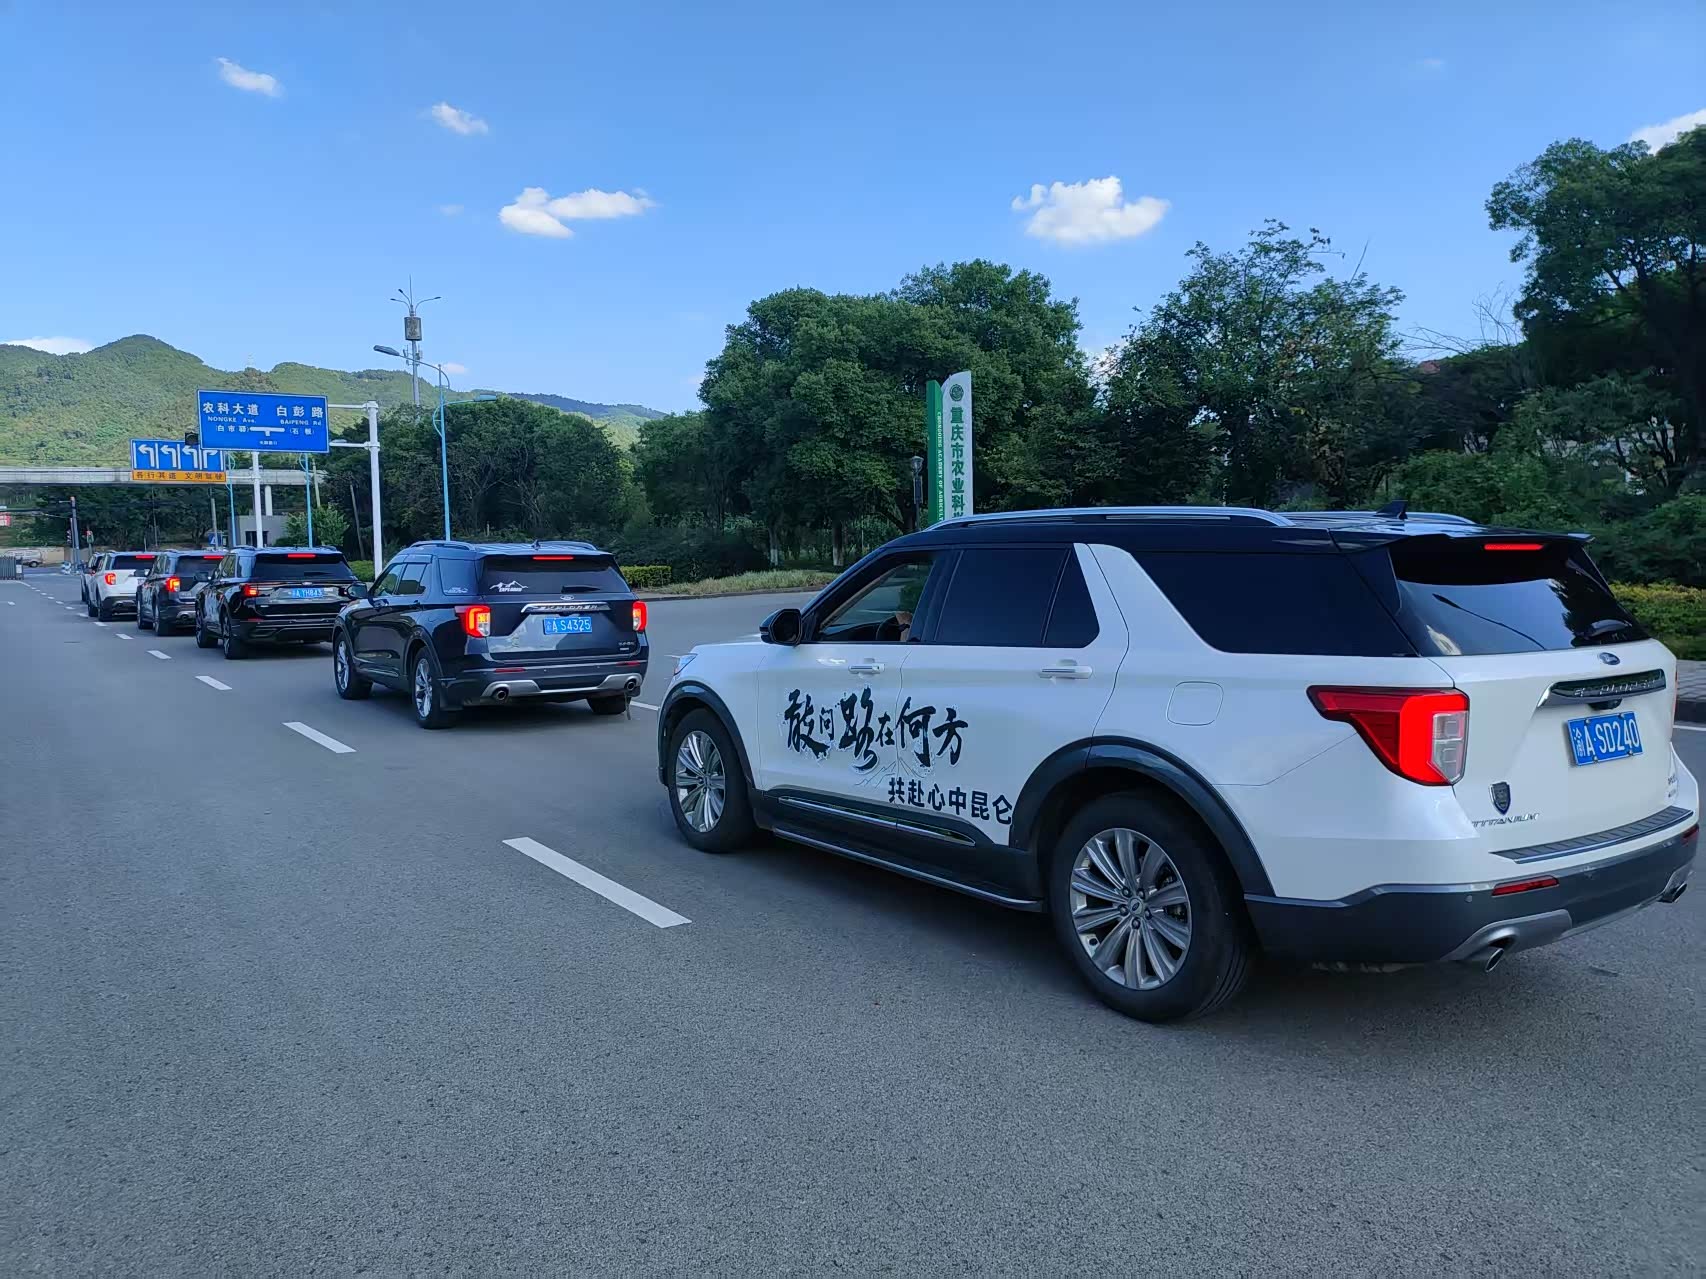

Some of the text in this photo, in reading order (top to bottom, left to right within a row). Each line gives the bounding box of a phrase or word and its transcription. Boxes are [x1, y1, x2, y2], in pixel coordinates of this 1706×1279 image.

[202, 401, 260, 416] 农科大道
[276, 405, 324, 418] 白彭路
[783, 684, 969, 772] 敢问路在何方
[887, 776, 1013, 825] 共赴心中昆仑
